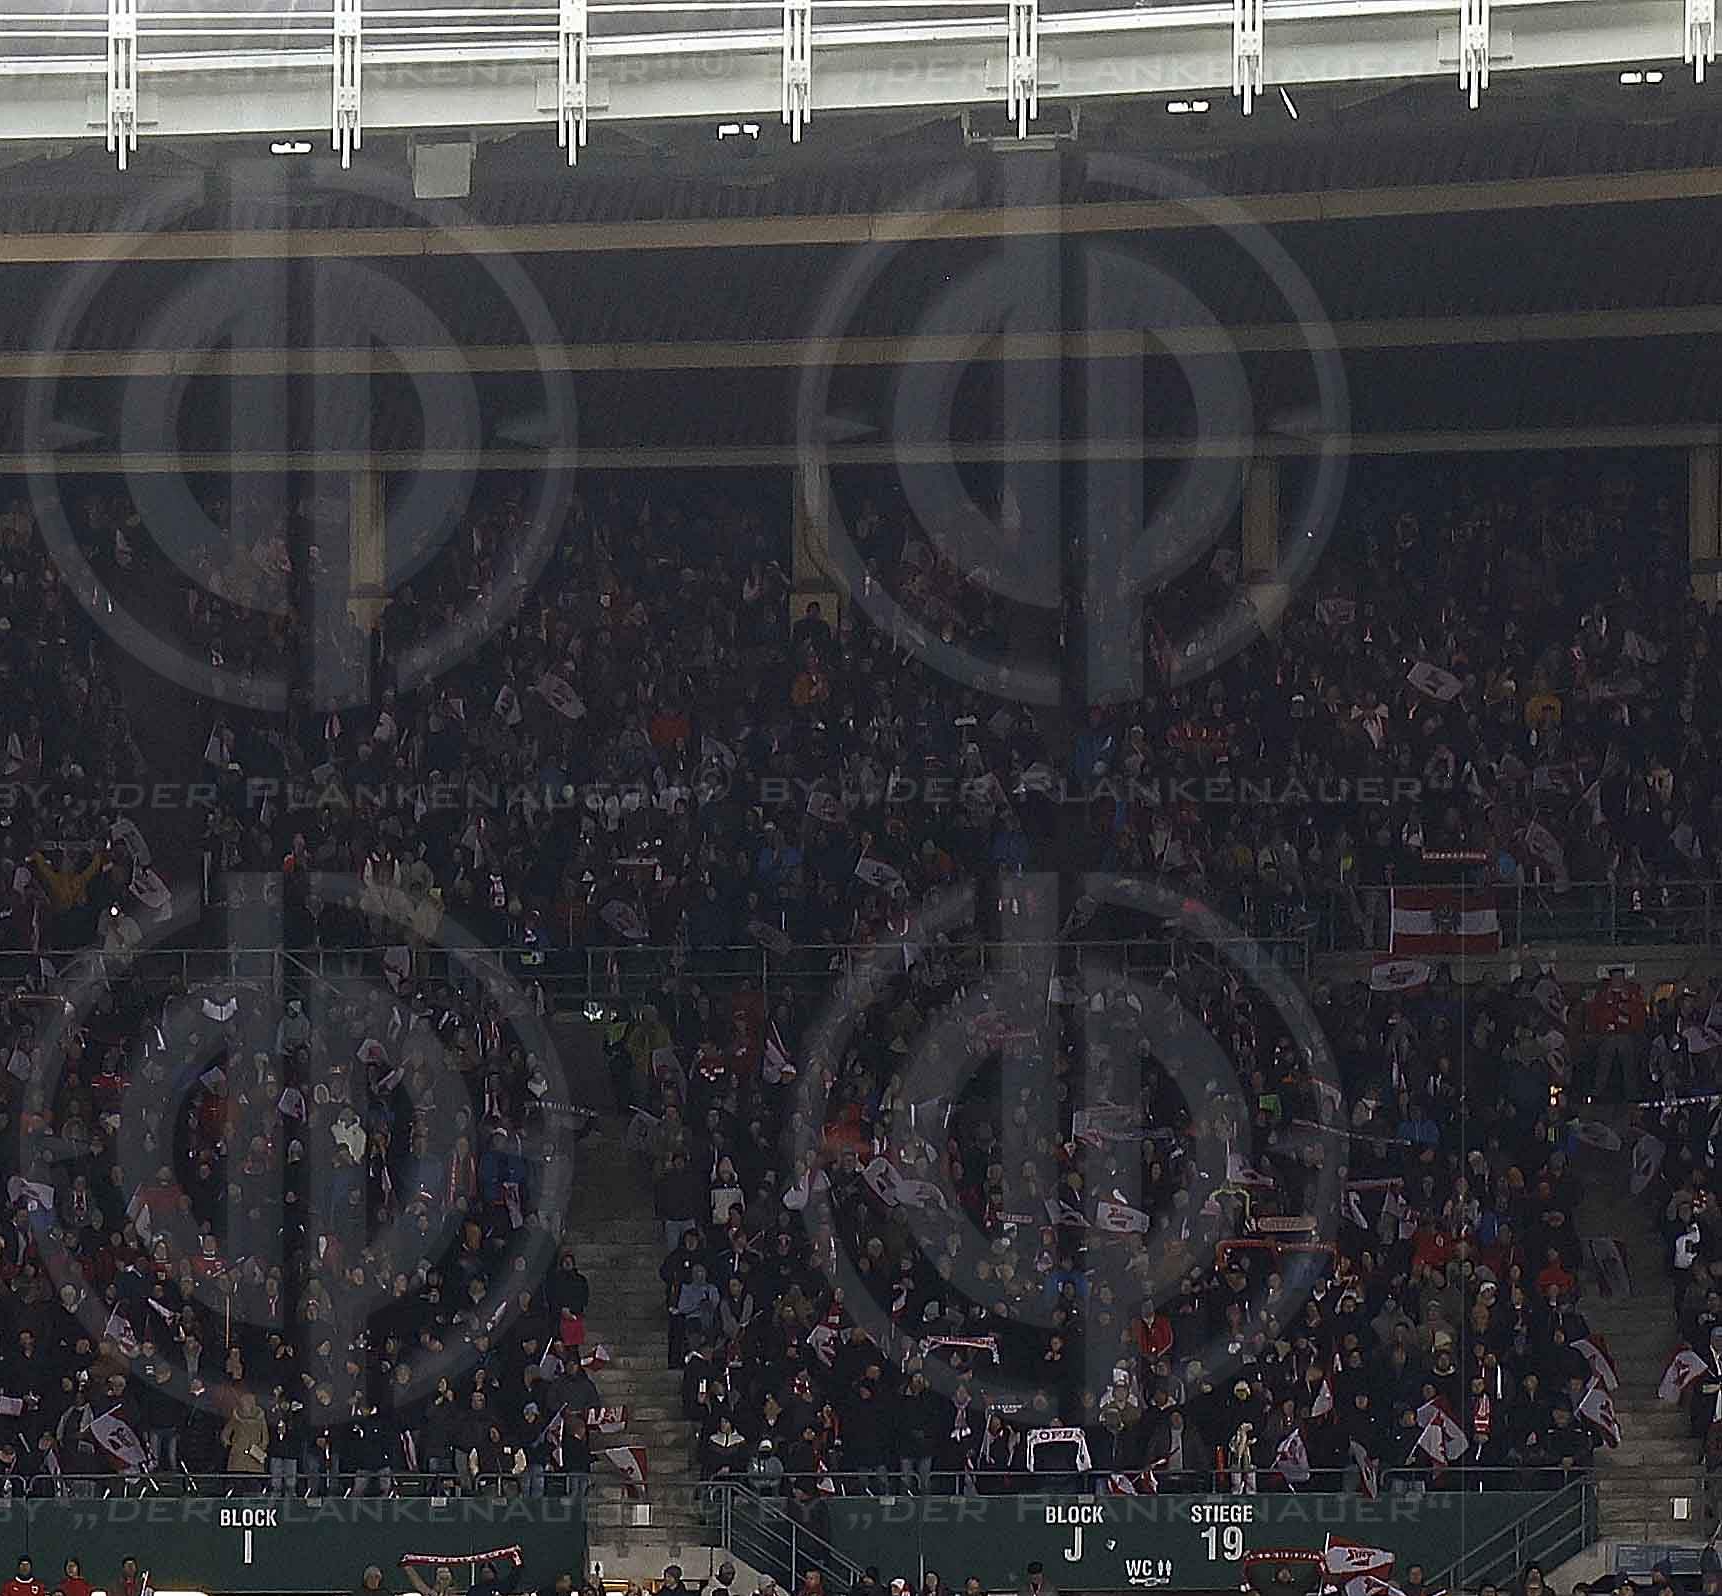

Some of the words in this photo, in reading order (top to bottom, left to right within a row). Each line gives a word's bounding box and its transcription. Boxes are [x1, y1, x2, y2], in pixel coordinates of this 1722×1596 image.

[220, 1508, 277, 1527] BLOCK
[1046, 1506, 1104, 1523] BLOCK
[1191, 1505, 1252, 1523] STIEGE
[244, 1529, 252, 1563] I
[1064, 1526, 1083, 1561] J
[1201, 1526, 1244, 1560] 19
[1126, 1560, 1153, 1577] WC
